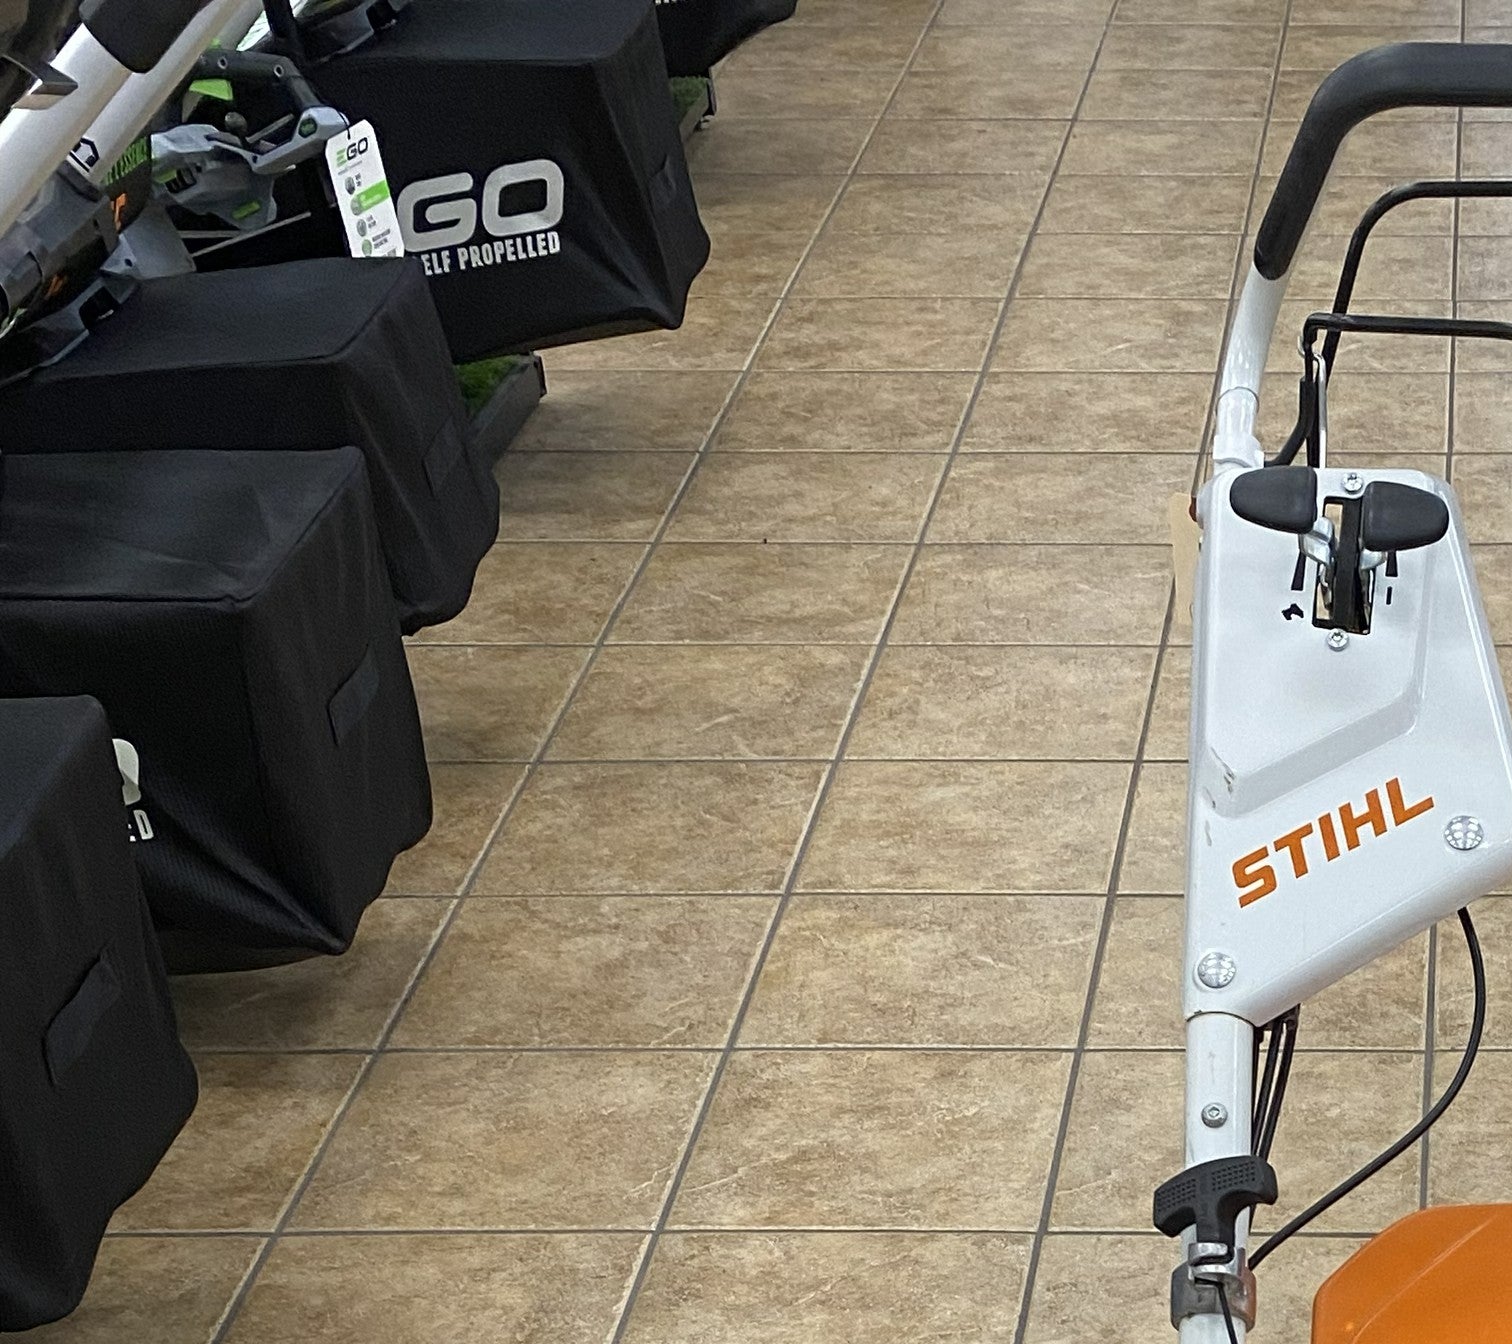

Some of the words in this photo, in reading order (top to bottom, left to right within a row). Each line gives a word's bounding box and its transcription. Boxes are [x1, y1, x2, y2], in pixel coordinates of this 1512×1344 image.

[397, 158, 564, 252] GO
[421, 249, 450, 276] ELF
[458, 231, 560, 271] PROPELLED
[1232, 777, 1435, 908] STIHL
